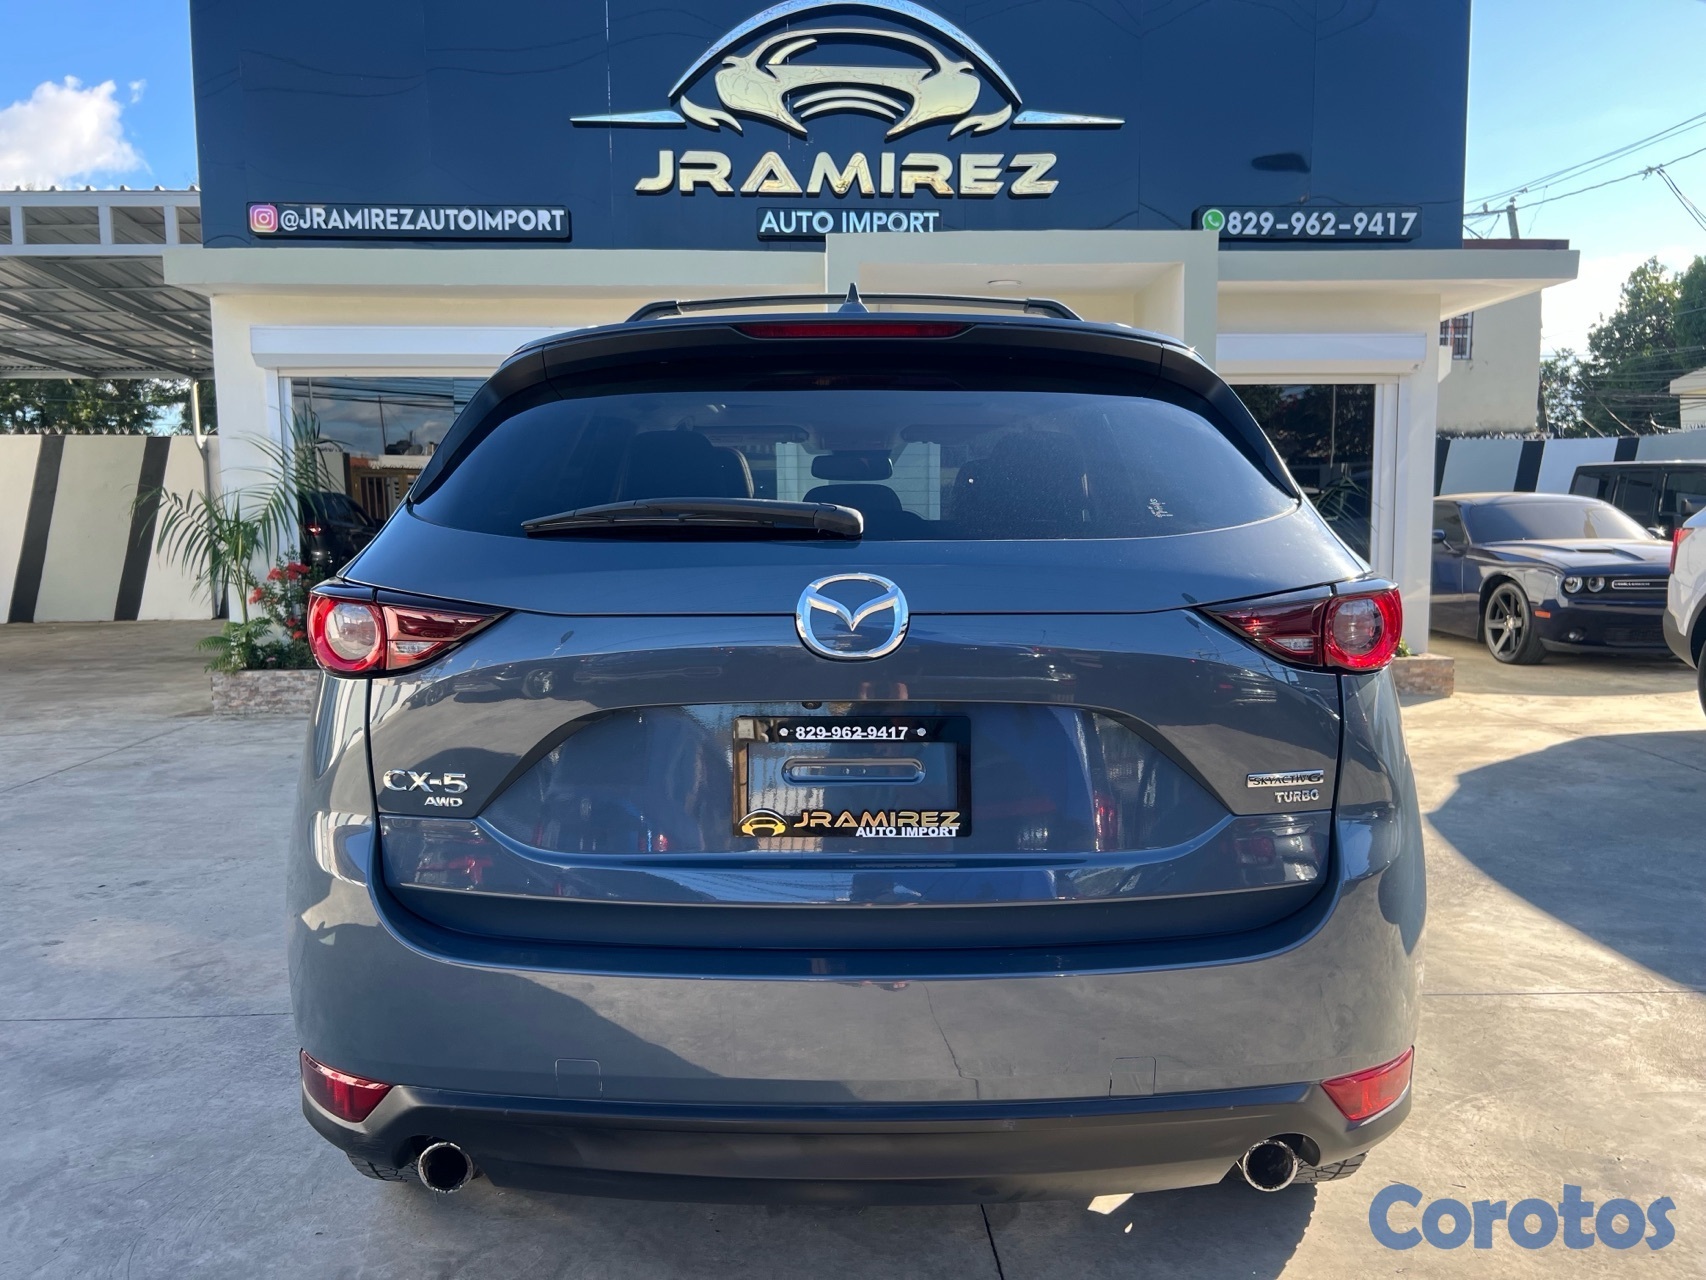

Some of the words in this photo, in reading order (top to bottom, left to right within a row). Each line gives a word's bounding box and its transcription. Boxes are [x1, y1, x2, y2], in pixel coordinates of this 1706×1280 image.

[634, 150, 1060, 195] JRAMIREZ
[280, 207, 566, 232] @JRAMIREZAUTOIMPORT
[759, 211, 835, 234] AUTO
[842, 211, 940, 234] IMPORT
[1227, 211, 1418, 236] 829-962-9417
[795, 726, 909, 740] 829-962-9417
[383, 769, 469, 793] CX-5
[424, 796, 464, 807] AWD
[1275, 789, 1320, 803] TURBO
[793, 811, 961, 828] JRAMIREZ
[856, 826, 897, 838] AUTO
[901, 826, 959, 838] IMPORT
